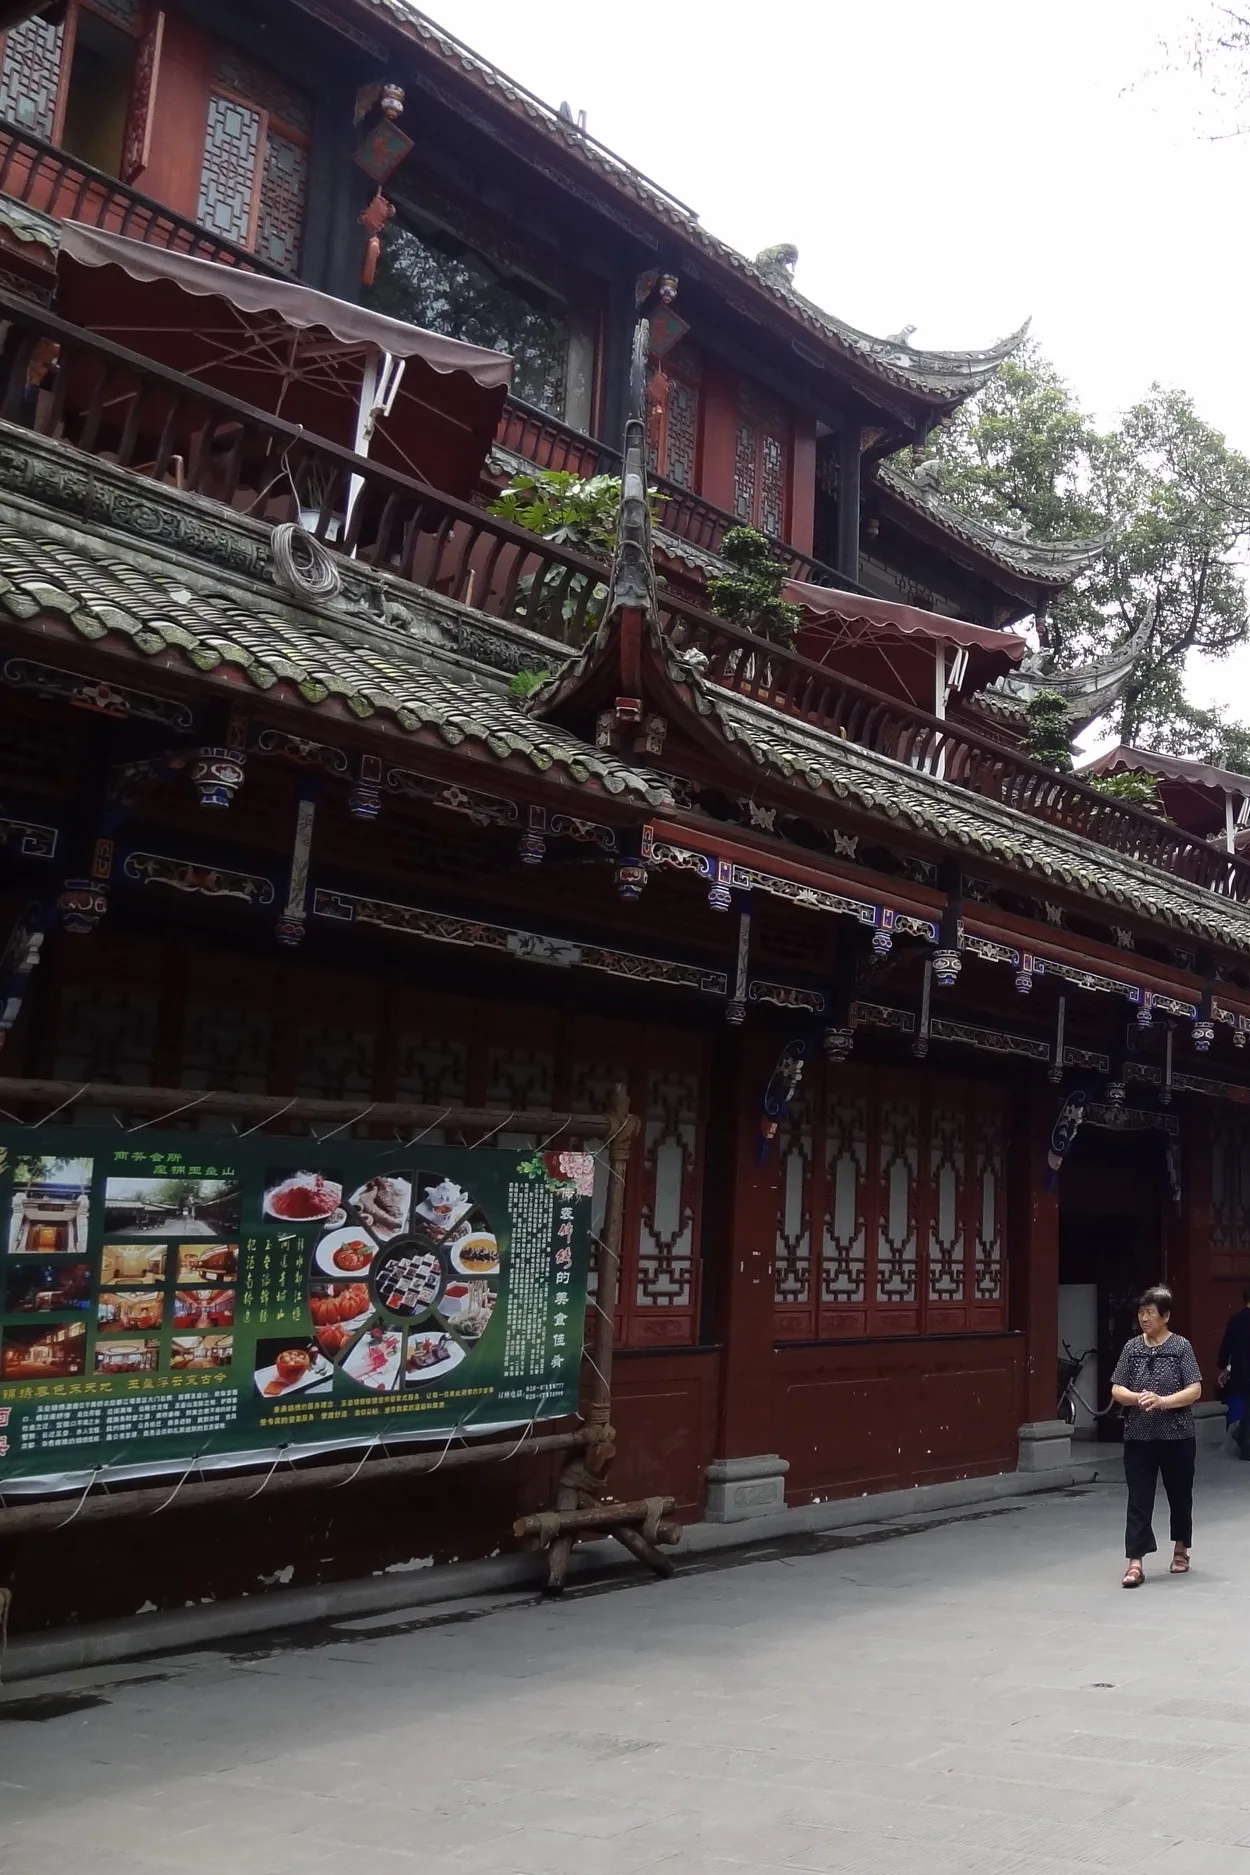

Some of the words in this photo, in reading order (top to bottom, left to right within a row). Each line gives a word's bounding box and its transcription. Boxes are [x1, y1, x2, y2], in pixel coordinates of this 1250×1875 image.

[113, 1150, 183, 1163] 商务会所
[551, 1187, 575, 1370] 锦绣的美食佳肴
